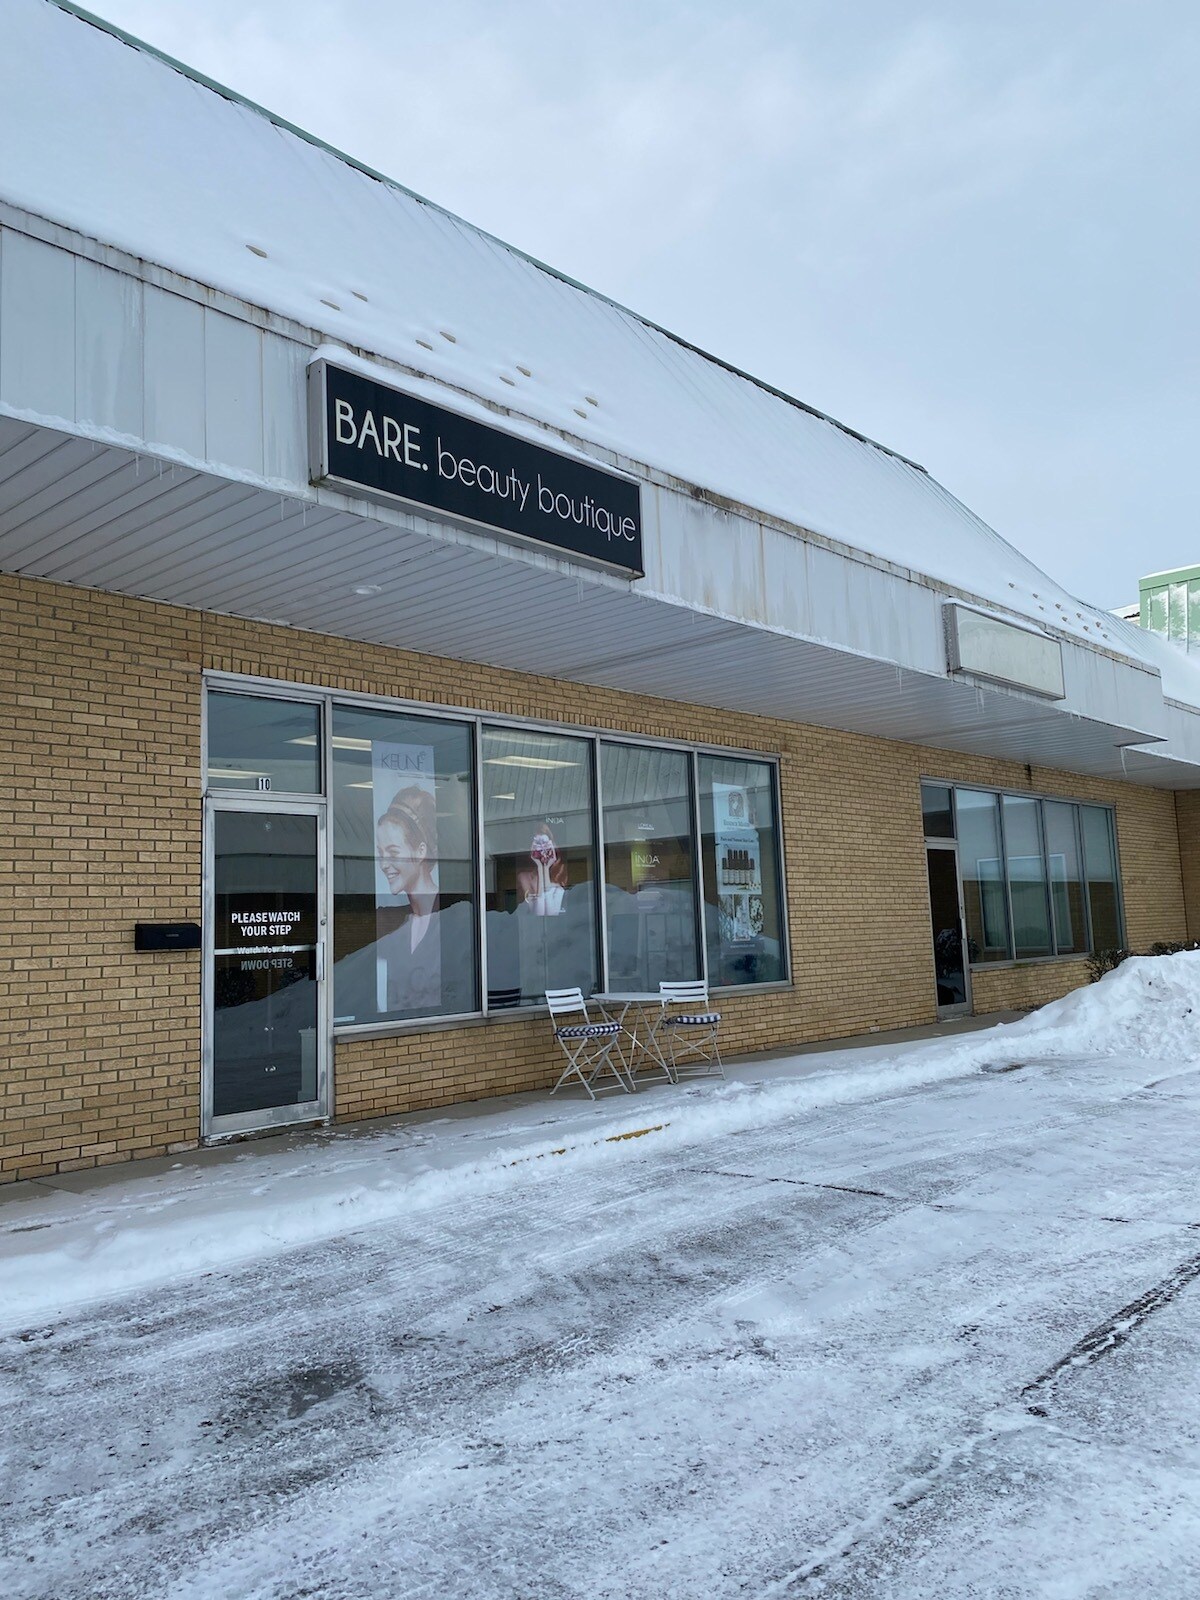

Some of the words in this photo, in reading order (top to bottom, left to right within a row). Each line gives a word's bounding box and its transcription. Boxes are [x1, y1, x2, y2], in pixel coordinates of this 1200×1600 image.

[334, 398, 429, 472] BARE.
[437, 436, 530, 511] beauty
[537, 473, 637, 541] boutique
[260, 778, 270, 790] 10
[231, 912, 267, 923] PLEASE
[268, 911, 300, 922] WATCH
[241, 925, 267, 936] YOUR
[269, 925, 292, 935] STEP
[236, 945, 261, 954] Watch
[262, 945, 280, 953] Your
